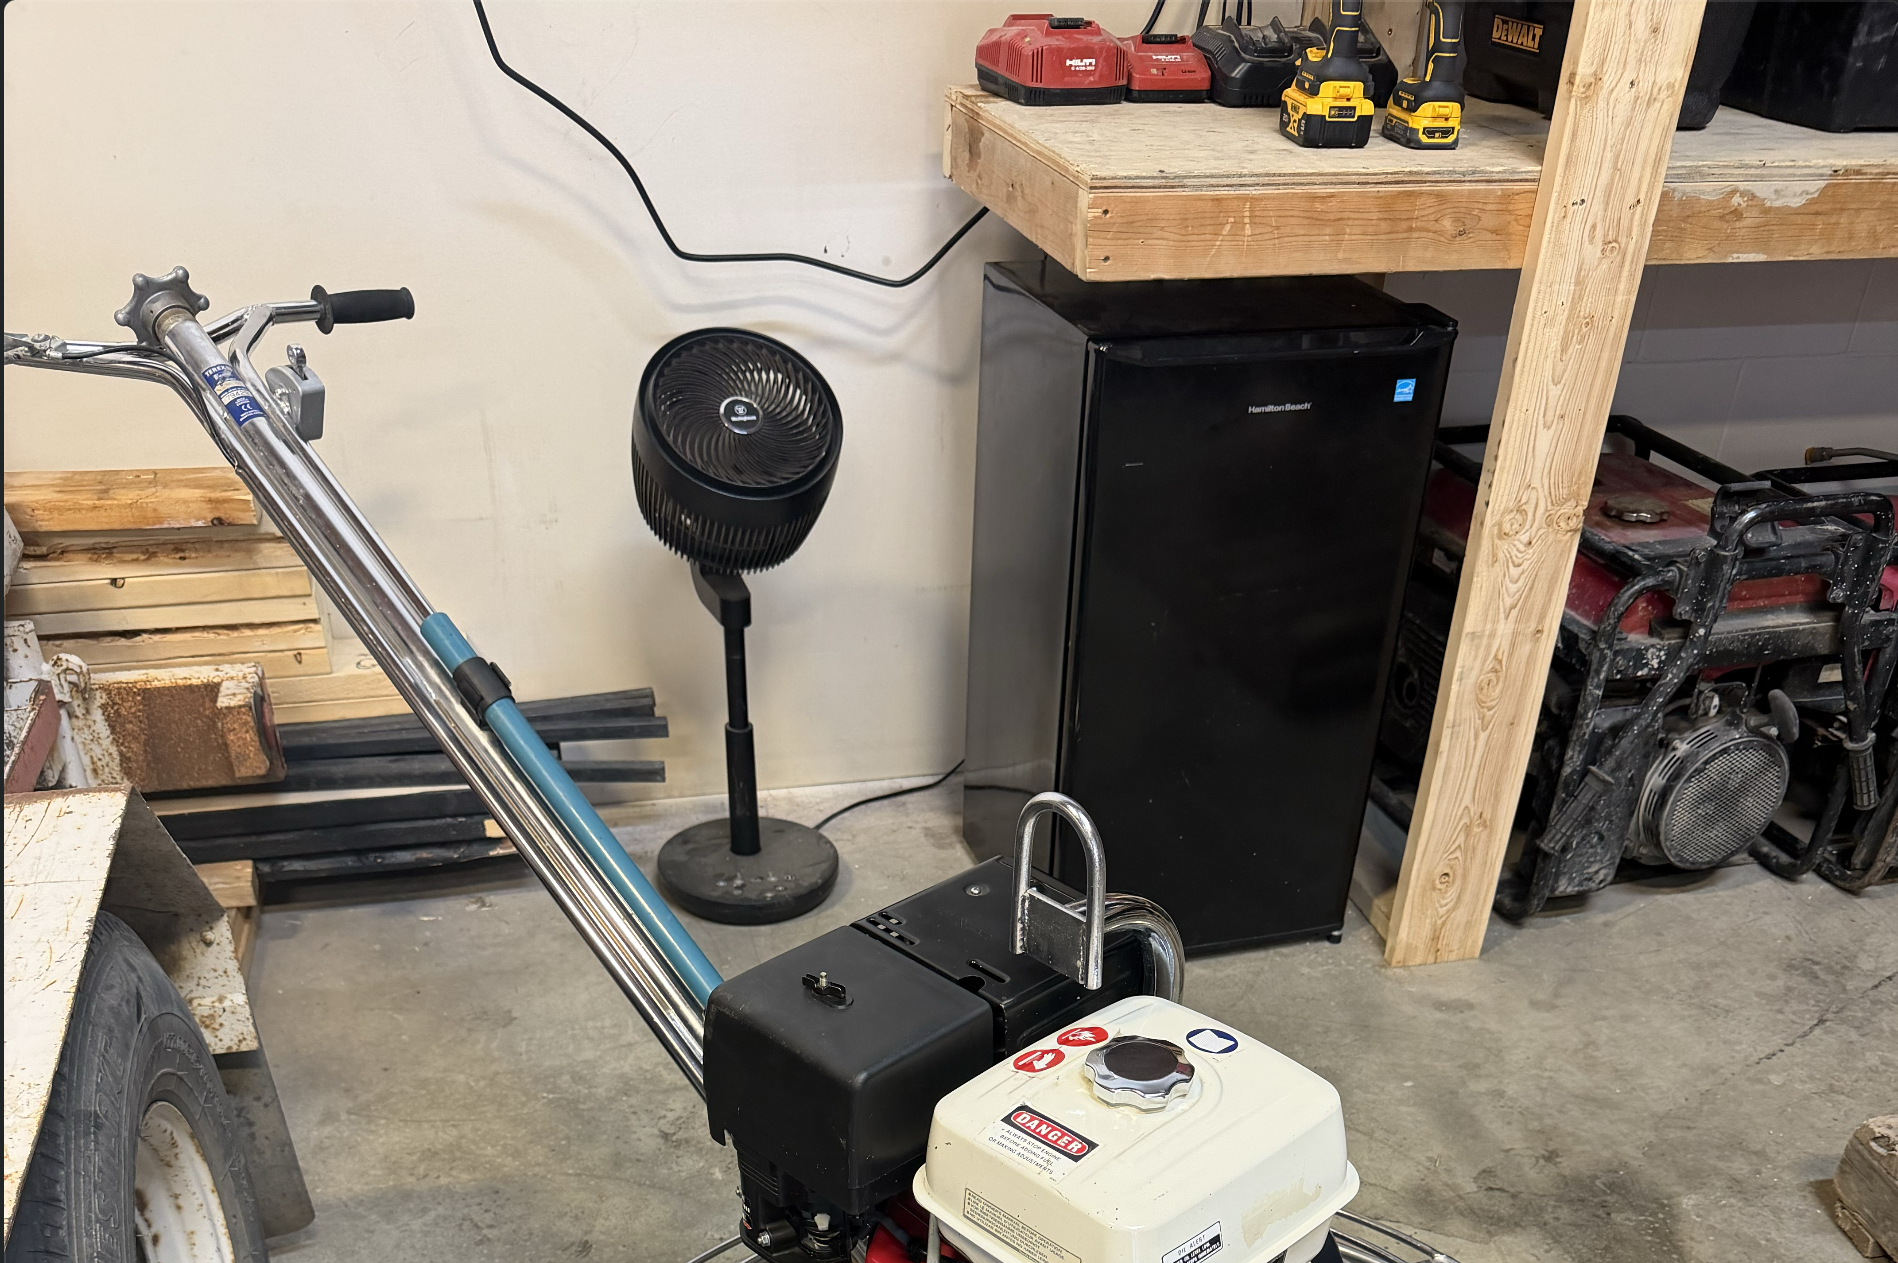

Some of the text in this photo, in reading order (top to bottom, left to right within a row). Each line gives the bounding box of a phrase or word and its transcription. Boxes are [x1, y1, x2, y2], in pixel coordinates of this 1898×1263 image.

[1248, 402, 1311, 414] Hamilton Beach
[1006, 1130, 1061, 1161] ALWAYS STOP ENGINE
[1016, 1113, 1083, 1152] DANGER
[997, 1141, 1016, 1153] MAKING
[1015, 1151, 1054, 1174] ADJUSTMENTS
[1000, 1135, 1053, 1166] BEFORE ADDING FUEL
[1190, 1235, 1205, 1248] ALERT
